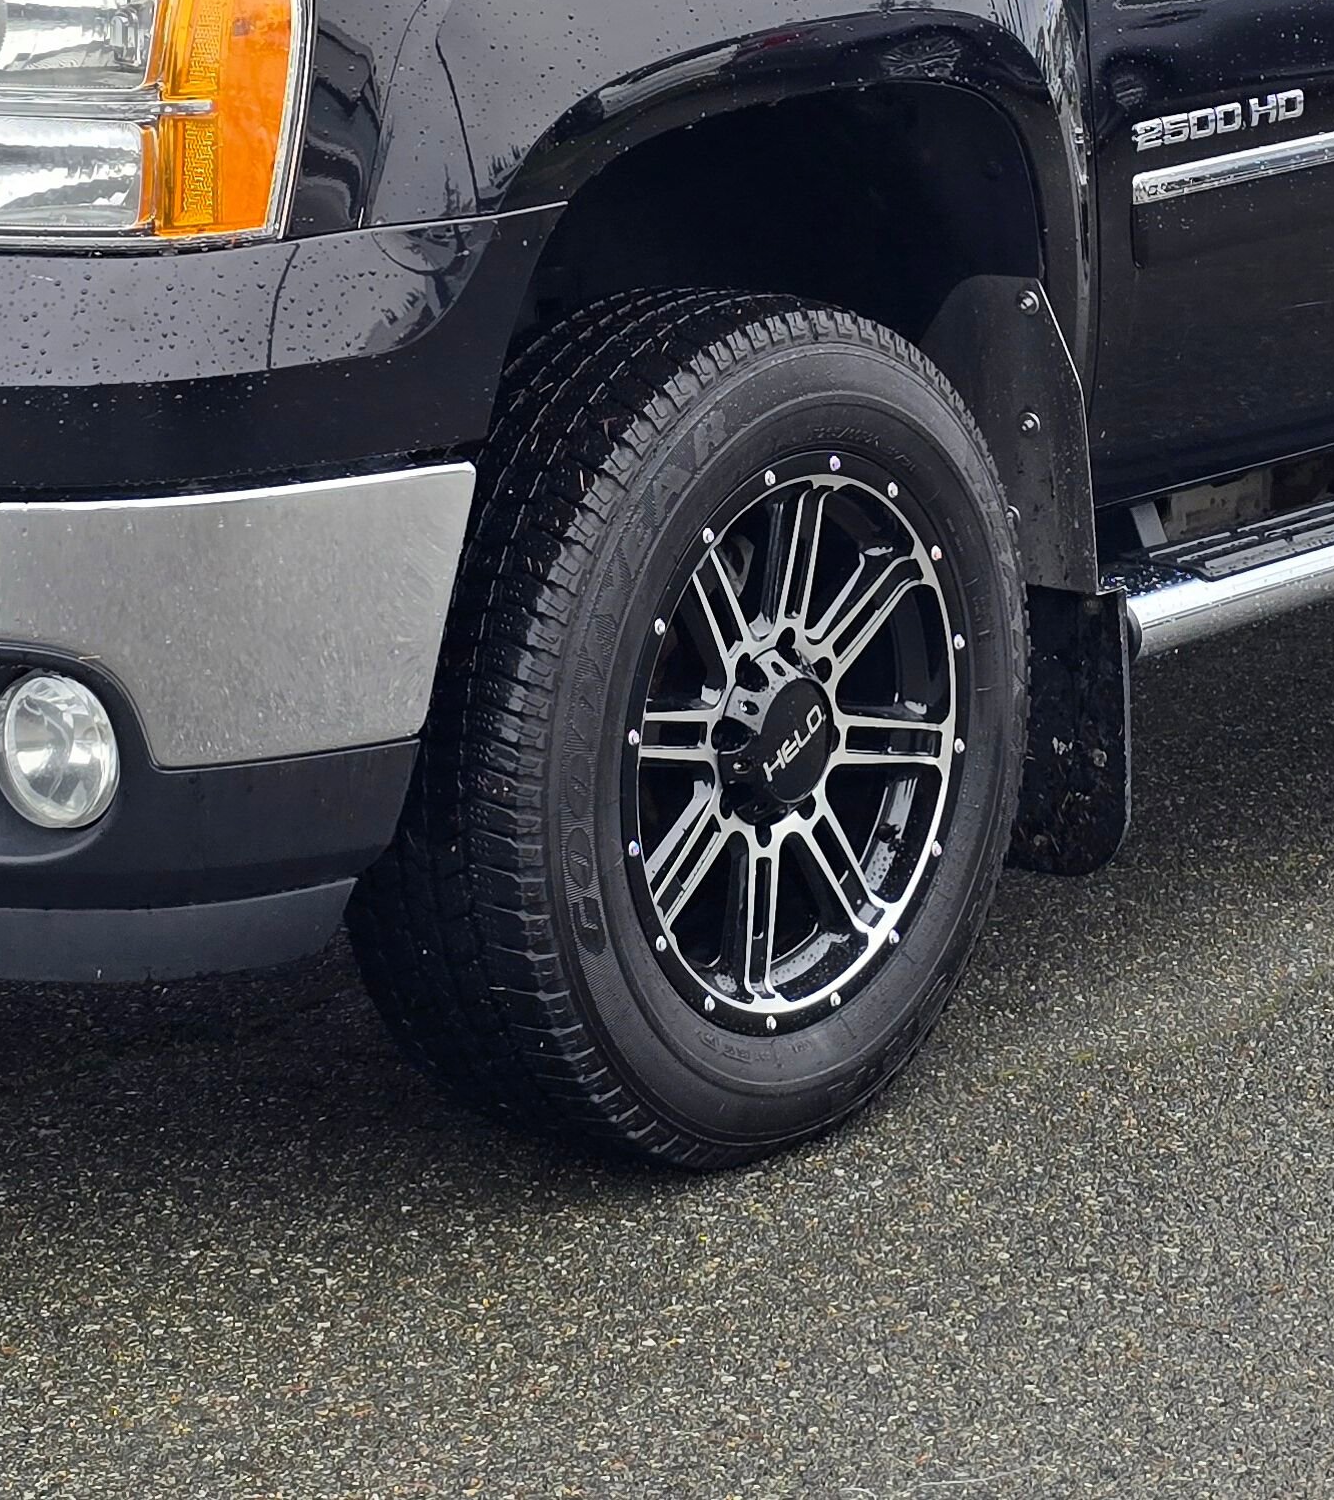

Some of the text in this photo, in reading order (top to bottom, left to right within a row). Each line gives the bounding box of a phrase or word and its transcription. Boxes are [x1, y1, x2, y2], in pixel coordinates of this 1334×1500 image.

[1131, 88, 1305, 152] 2500 HD
[763, 705, 823, 782] HELO
